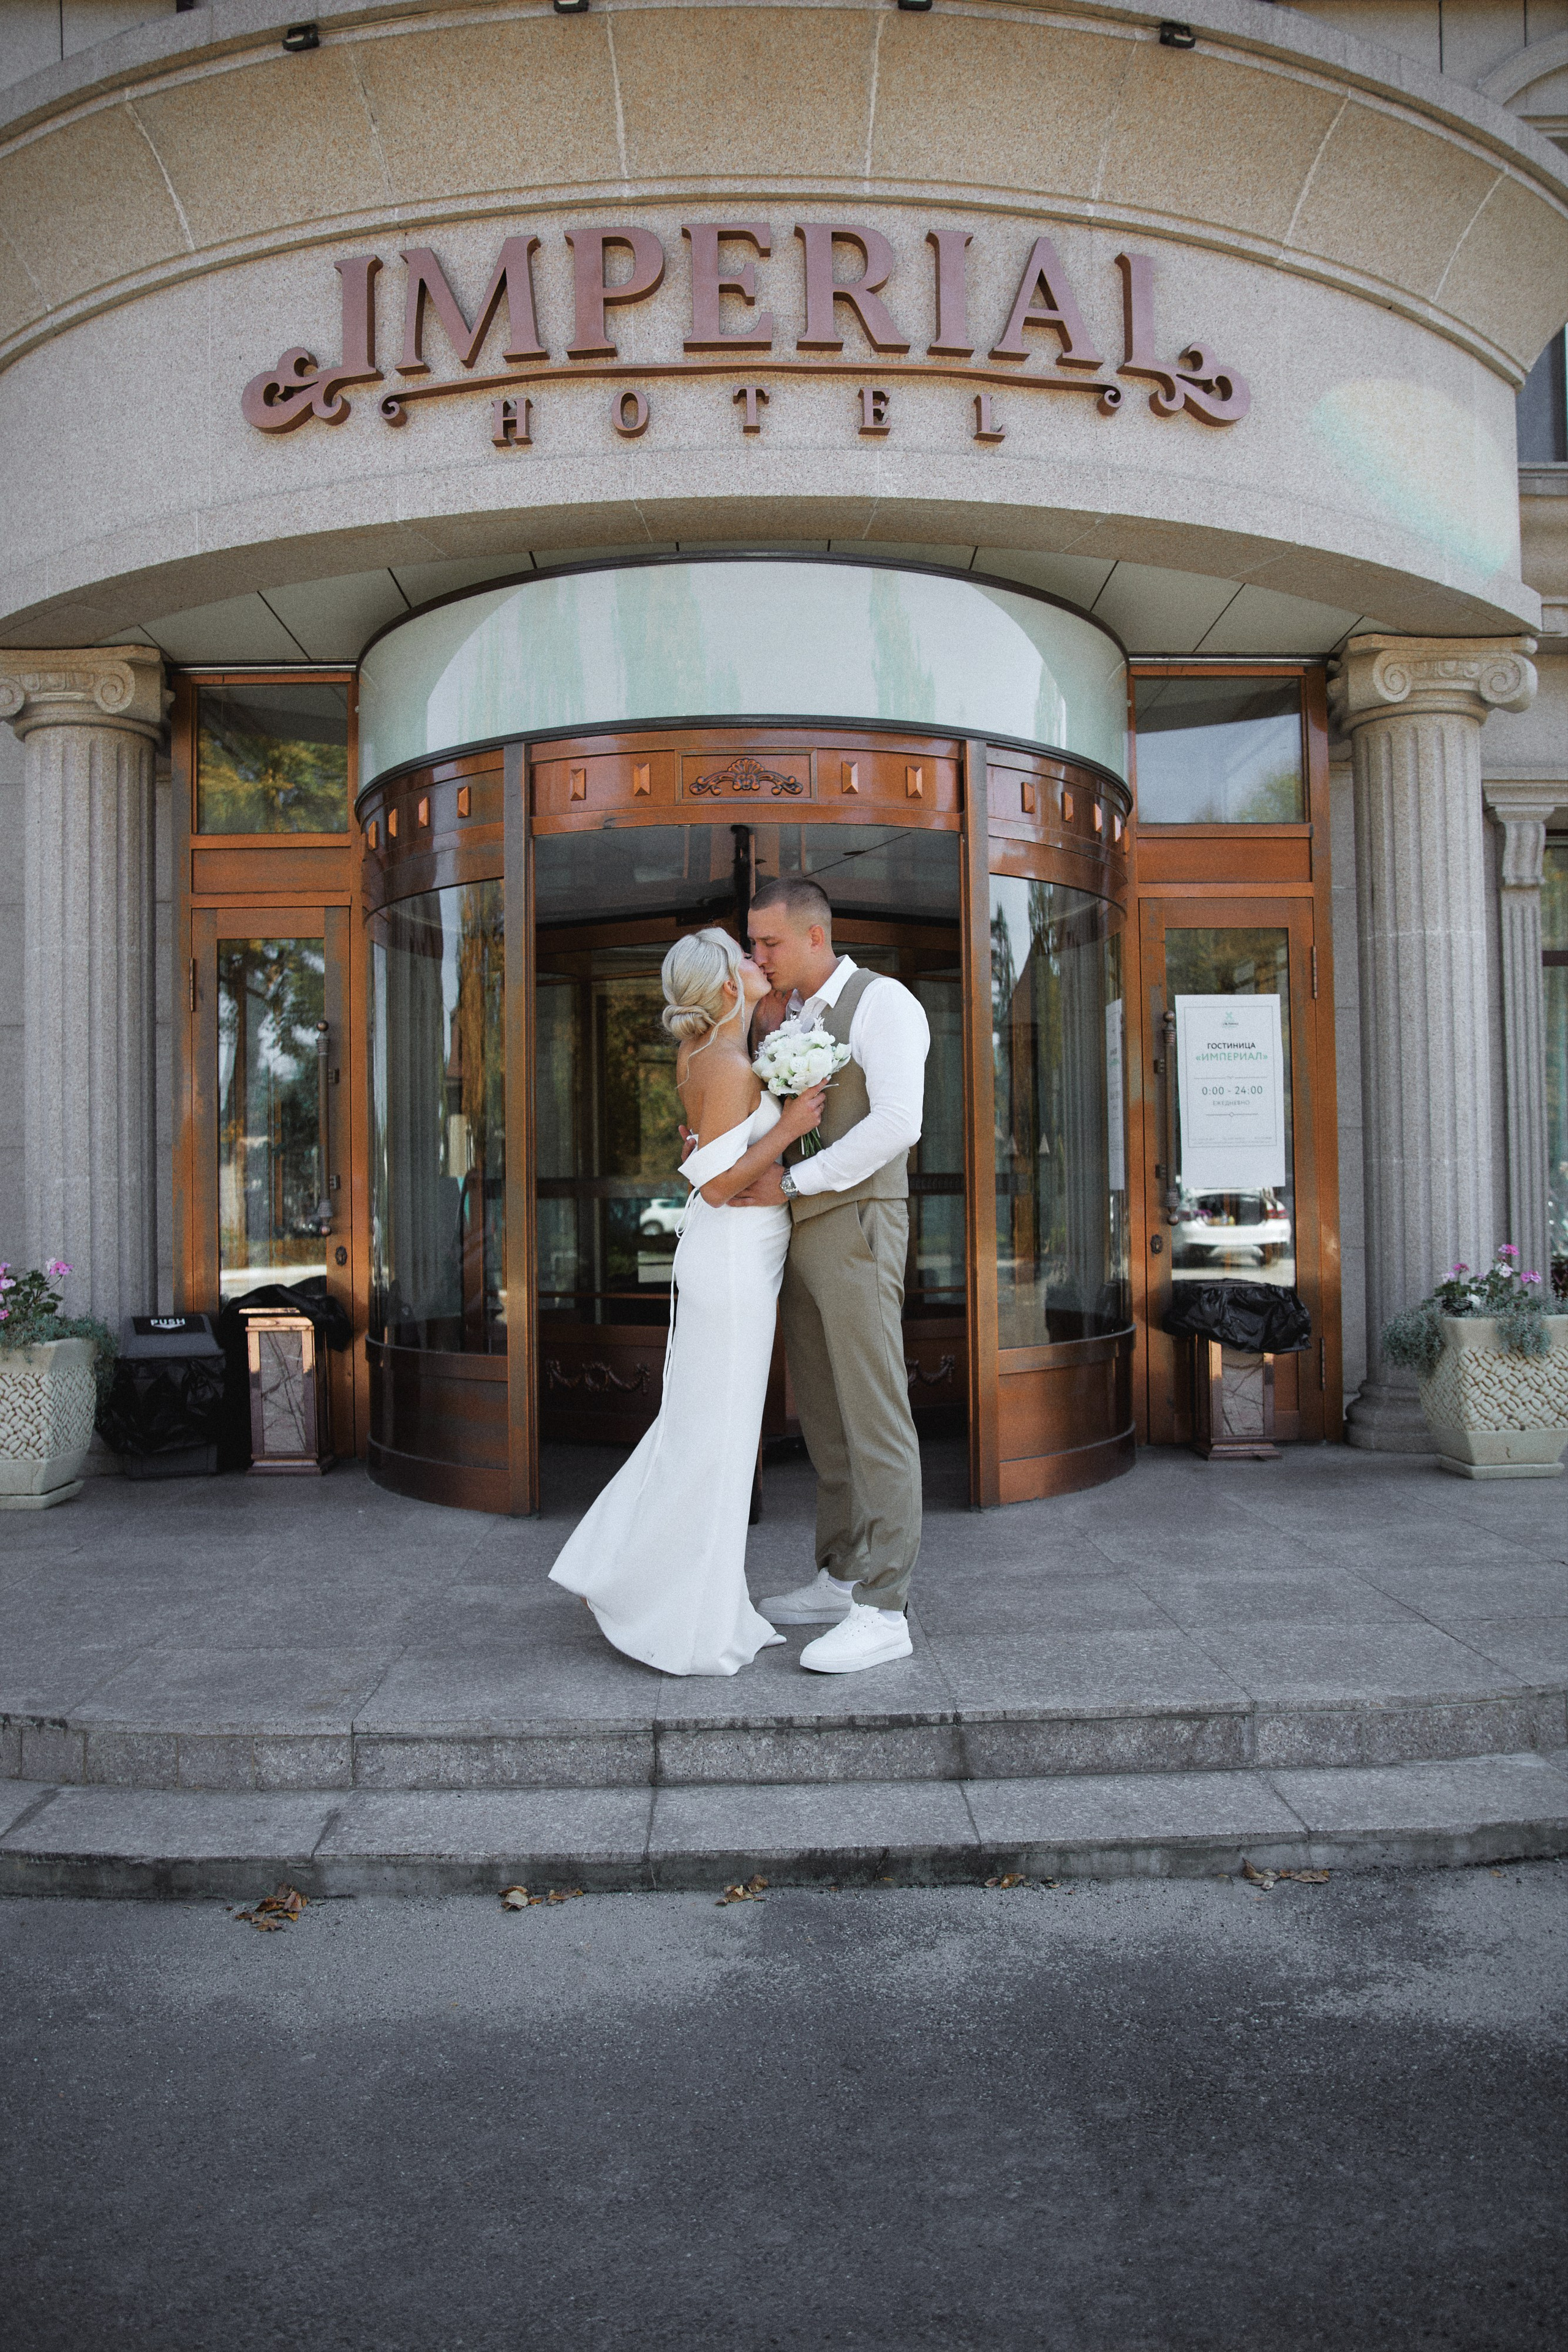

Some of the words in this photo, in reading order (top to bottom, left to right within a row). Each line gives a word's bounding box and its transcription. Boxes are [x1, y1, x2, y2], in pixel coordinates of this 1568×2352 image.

[322, 222, 1179, 383] IMPERIAL
[491, 385, 1005, 447] HOTEL
[1196, 1052, 1268, 1061] «ИМПЕРИАЛ»
[1202, 1087, 1224, 1095] 0:00
[1235, 1085, 1263, 1095] 24:00
